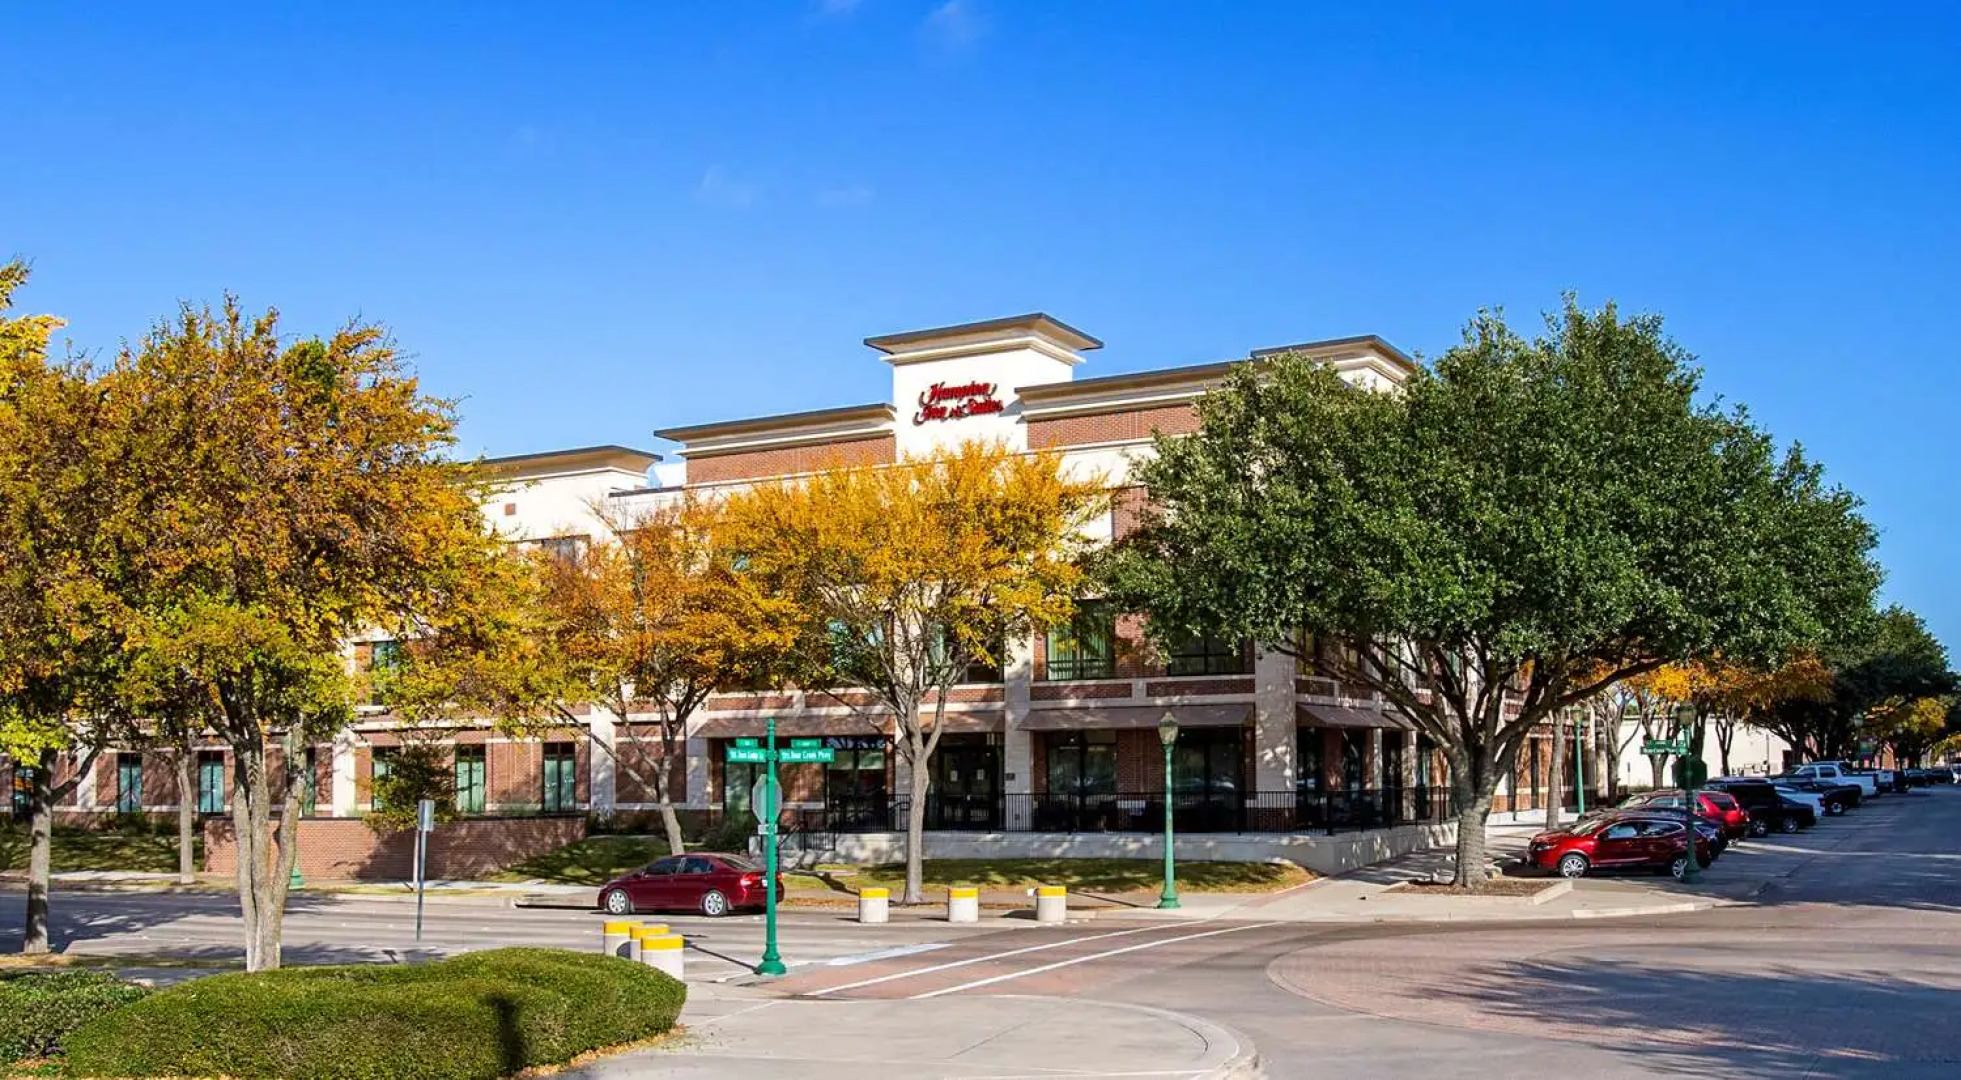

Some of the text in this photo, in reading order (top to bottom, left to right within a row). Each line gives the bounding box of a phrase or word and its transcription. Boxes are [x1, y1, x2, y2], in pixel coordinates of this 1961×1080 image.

[918, 381, 998, 408] Hampton
[912, 405, 949, 426] Inn
[963, 399, 1004, 417] Suites
